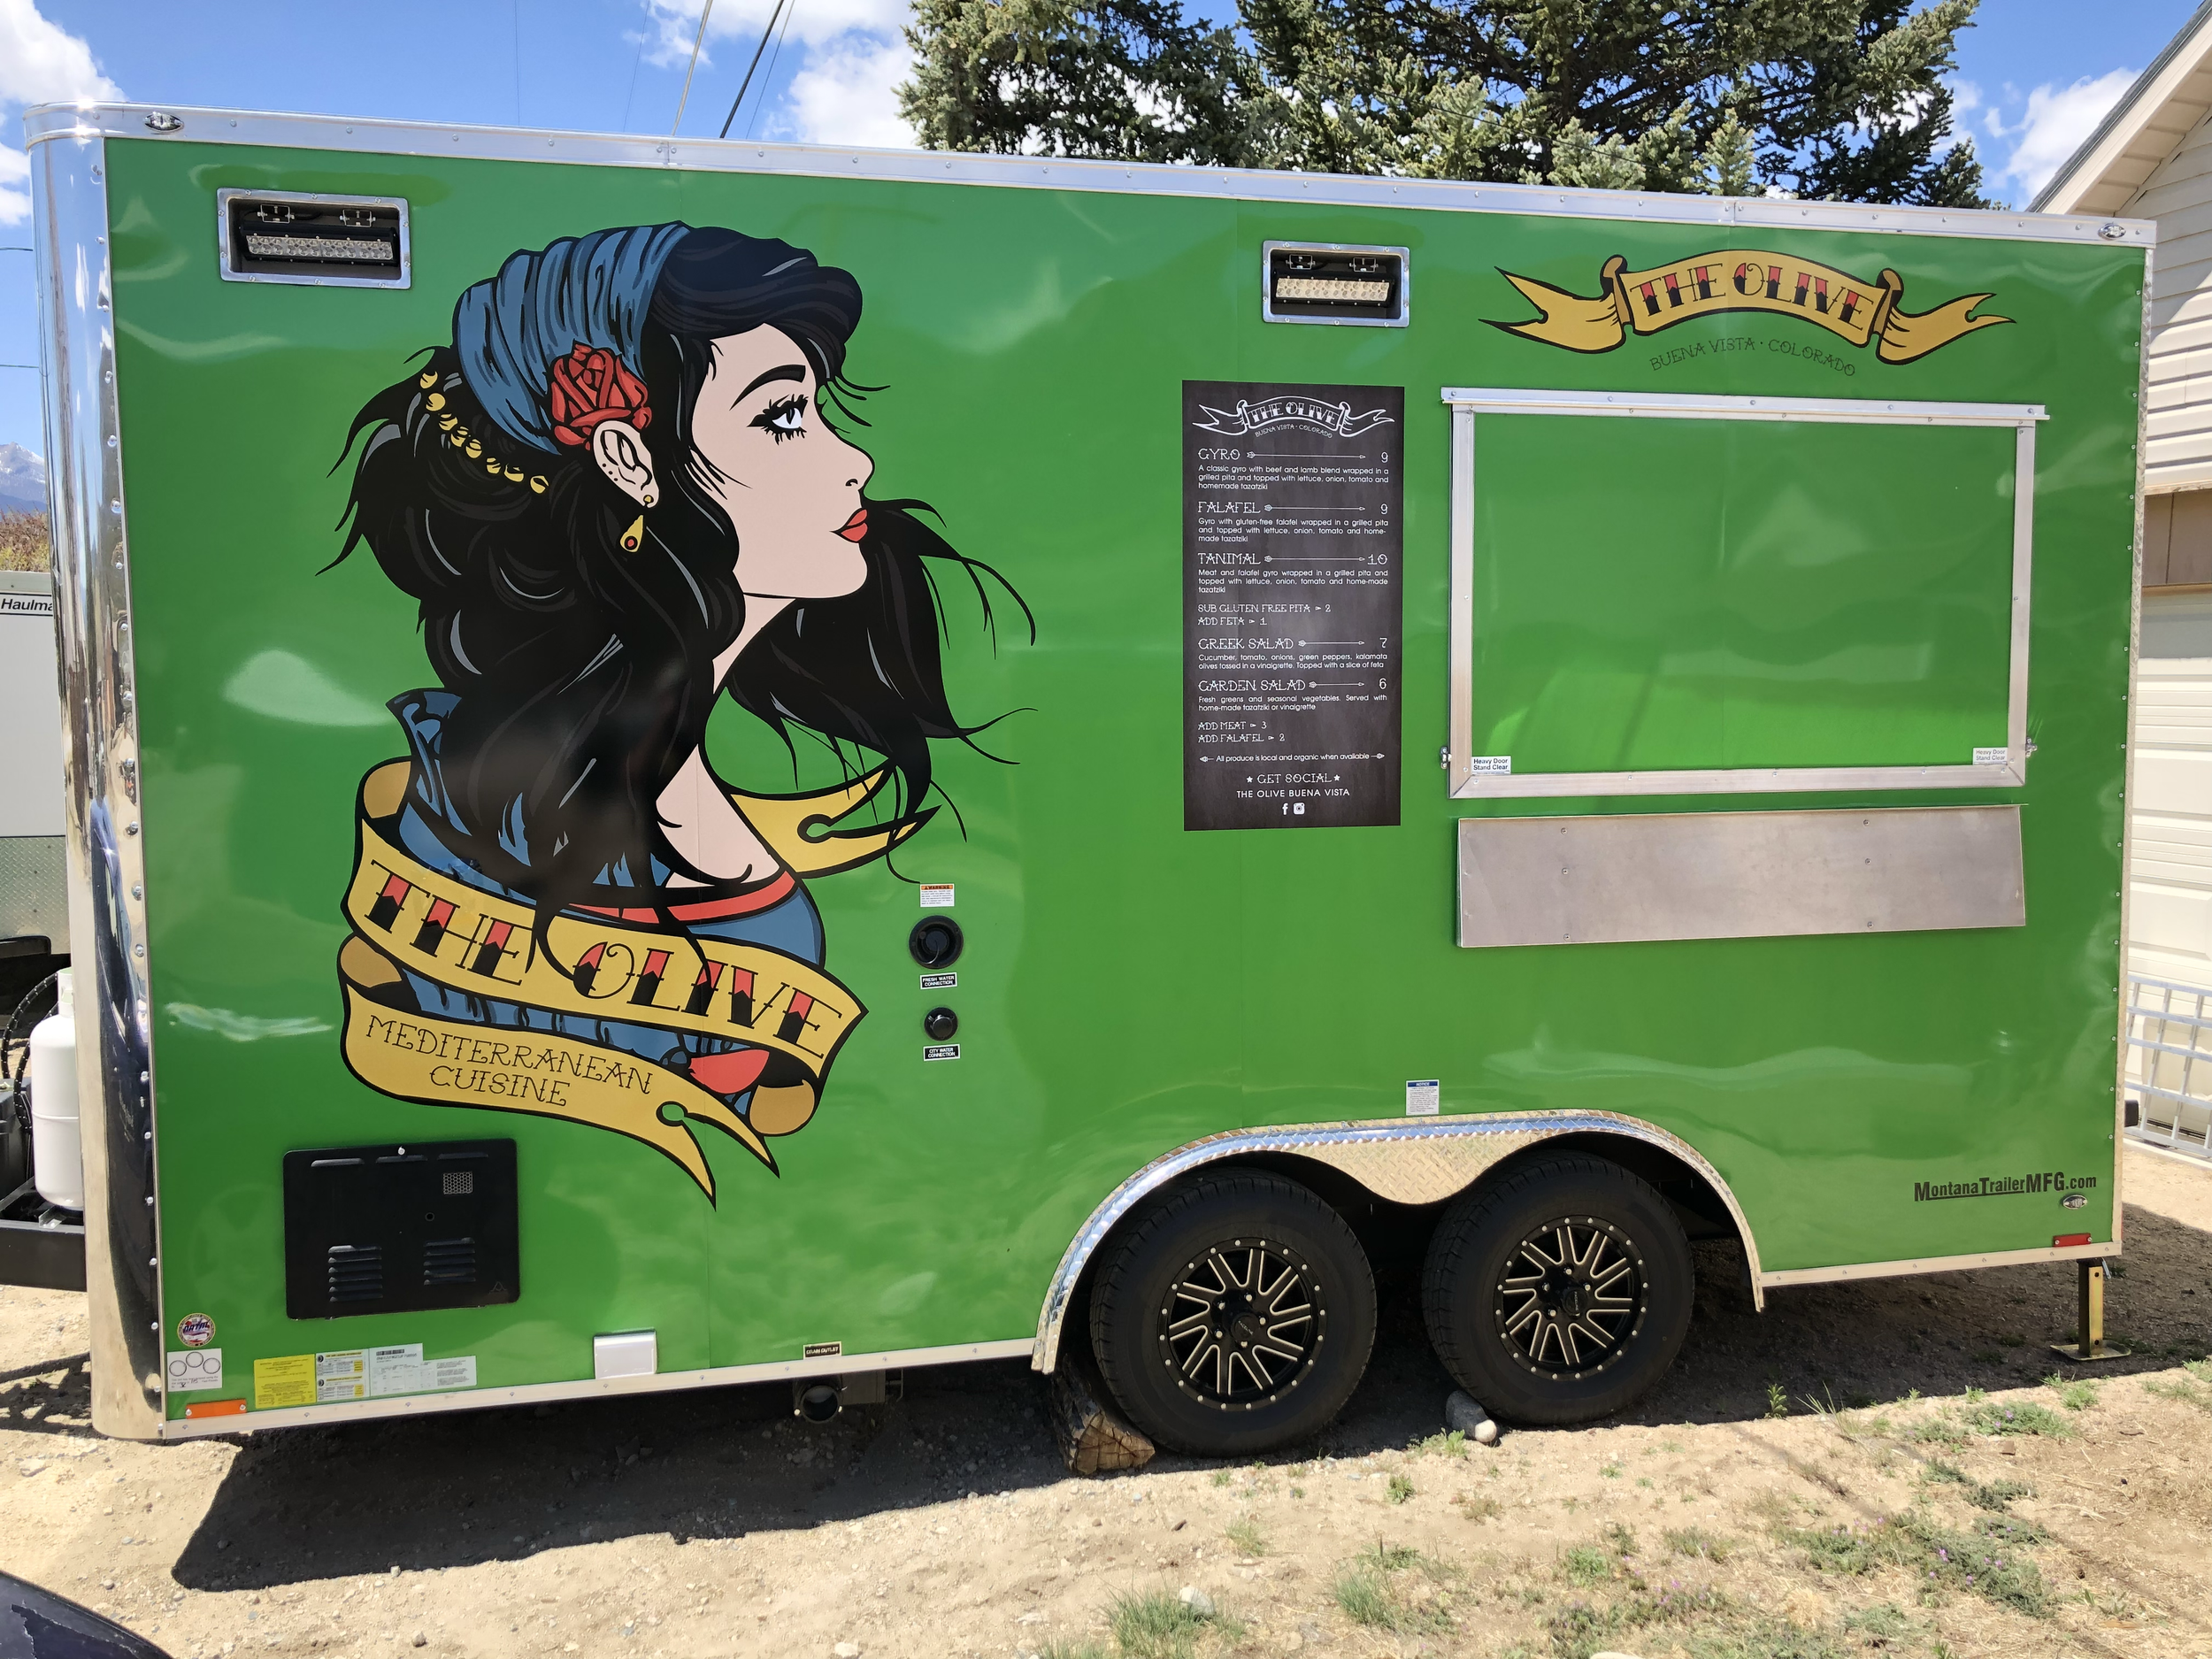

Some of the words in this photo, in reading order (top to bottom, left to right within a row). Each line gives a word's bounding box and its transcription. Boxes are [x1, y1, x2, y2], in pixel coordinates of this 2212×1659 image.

[1630, 263, 1726, 317] THE
[1732, 262, 1874, 331] OLIVE
[1649, 342, 1706, 371] BUENA
[1709, 337, 1755, 353] VISTA
[1768, 339, 1855, 376] COLORADO
[1247, 403, 1284, 423] THE
[1286, 402, 1339, 426] OLIVE
[1255, 426, 1275, 437] BUENA
[1299, 425, 1333, 438] COLORADO
[1198, 449, 1240, 459] GYRO
[1381, 452, 1388, 463] 9
[1198, 502, 1261, 513] FALAFEL
[1380, 503, 1387, 514] 9
[1198, 553, 1261, 564] TANIMAL
[1368, 554, 1387, 565] 10
[1198, 638, 1244, 649] GREEK
[1248, 638, 1294, 649] SALAD
[1379, 638, 1387, 648] 7
[1198, 680, 1256, 691] GARDEN
[1261, 680, 1305, 690] SALAD
[1379, 678, 1386, 689] 6
[1220, 721, 1246, 730] MEAT
[1220, 733, 1264, 742] FALAFEL
[1256, 774, 1282, 784] GET
[1285, 773, 1332, 783] SOCIAL
[364, 858, 535, 987] THE
[571, 940, 842, 1060] OLIVE
[365, 1013, 655, 1095] MEDITERRANEAN
[428, 1064, 571, 1108] CUISINE
[1914, 1171, 2097, 1202] MontanaTrailerMFG.com
